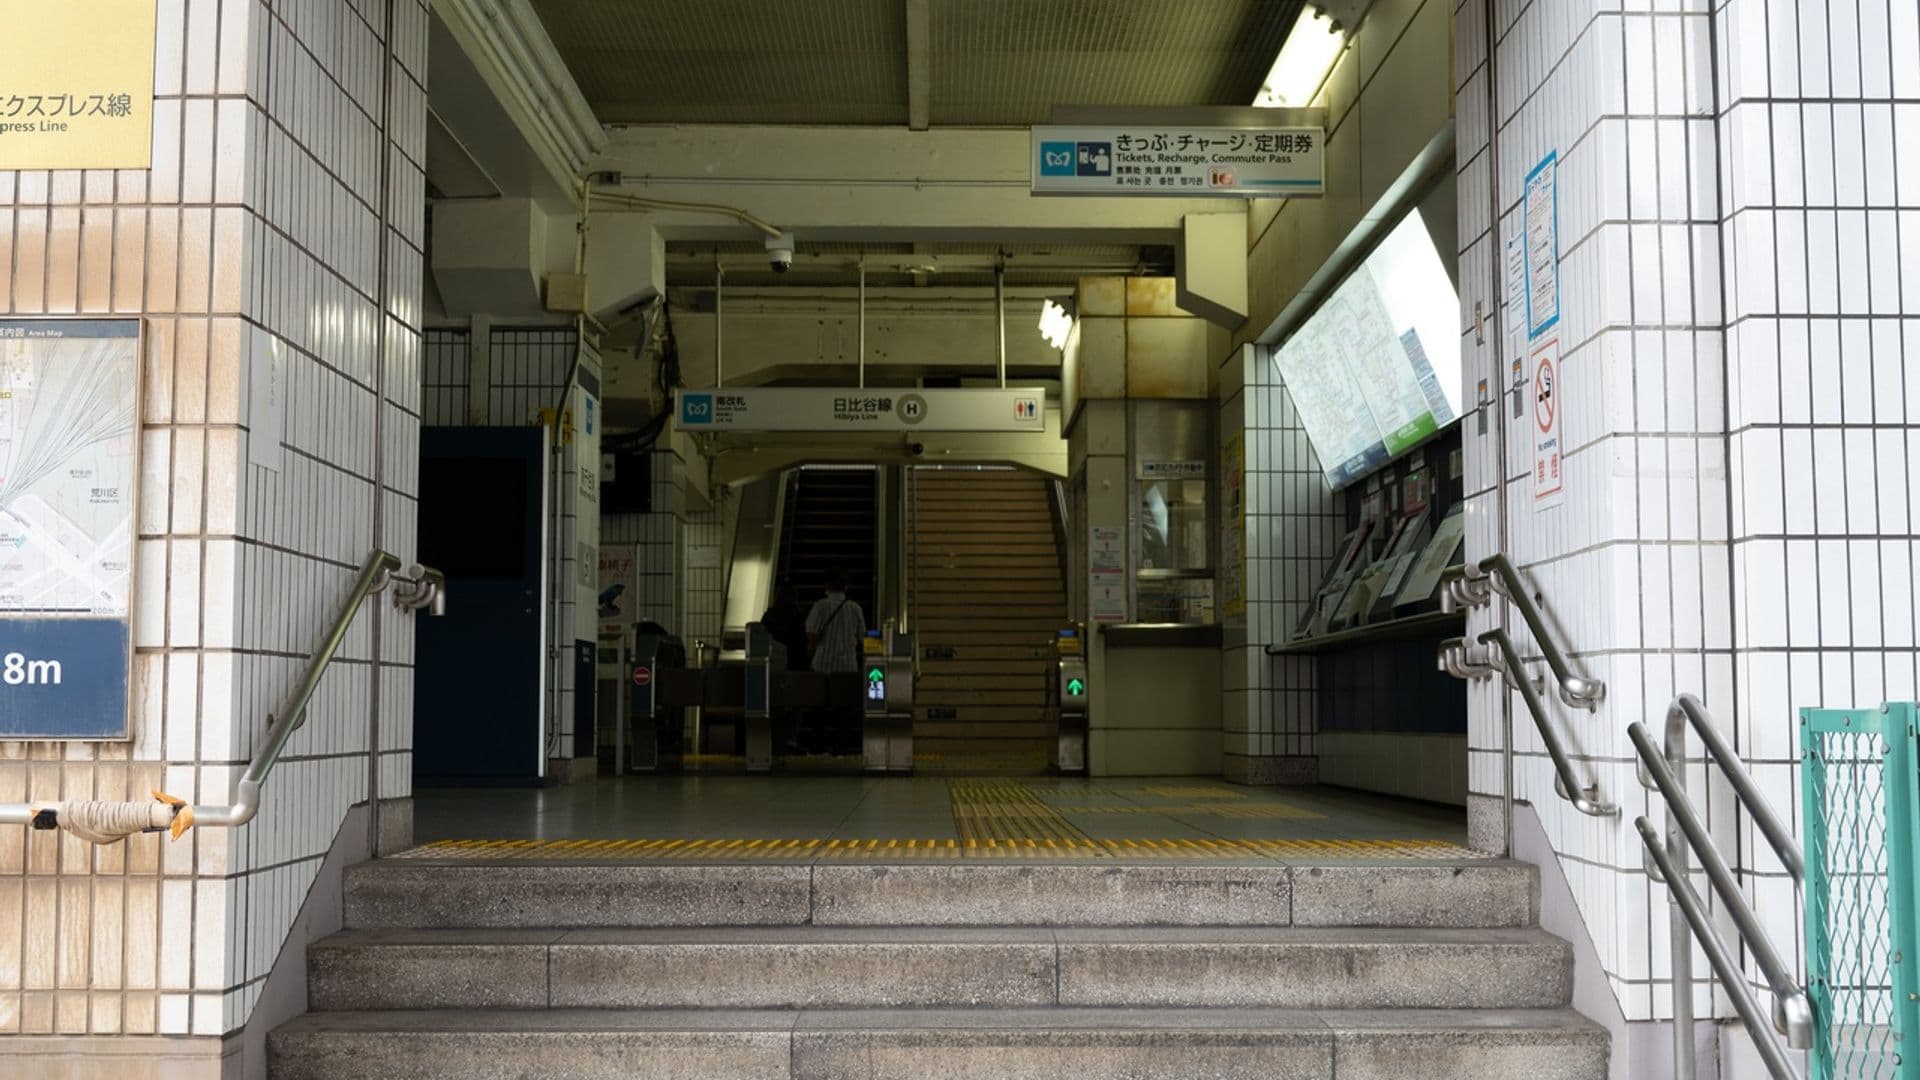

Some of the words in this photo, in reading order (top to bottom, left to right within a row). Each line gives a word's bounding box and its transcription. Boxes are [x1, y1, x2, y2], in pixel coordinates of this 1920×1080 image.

[40, 120, 68, 132] Line
[1116, 133, 1313, 153] きっぷ・チャージ・定期券
[1116, 153, 1155, 163] Tickets,
[1157, 153, 1209, 165] Recharge,
[1211, 154, 1266, 164] Commuter
[1269, 154, 1292, 163] Pass
[833, 397, 893, 412] 日比谷線
[906, 402, 918, 416] H
[833, 413, 860, 422] Hibiya
[861, 413, 879, 421] Line
[3, 652, 62, 685] 8m
